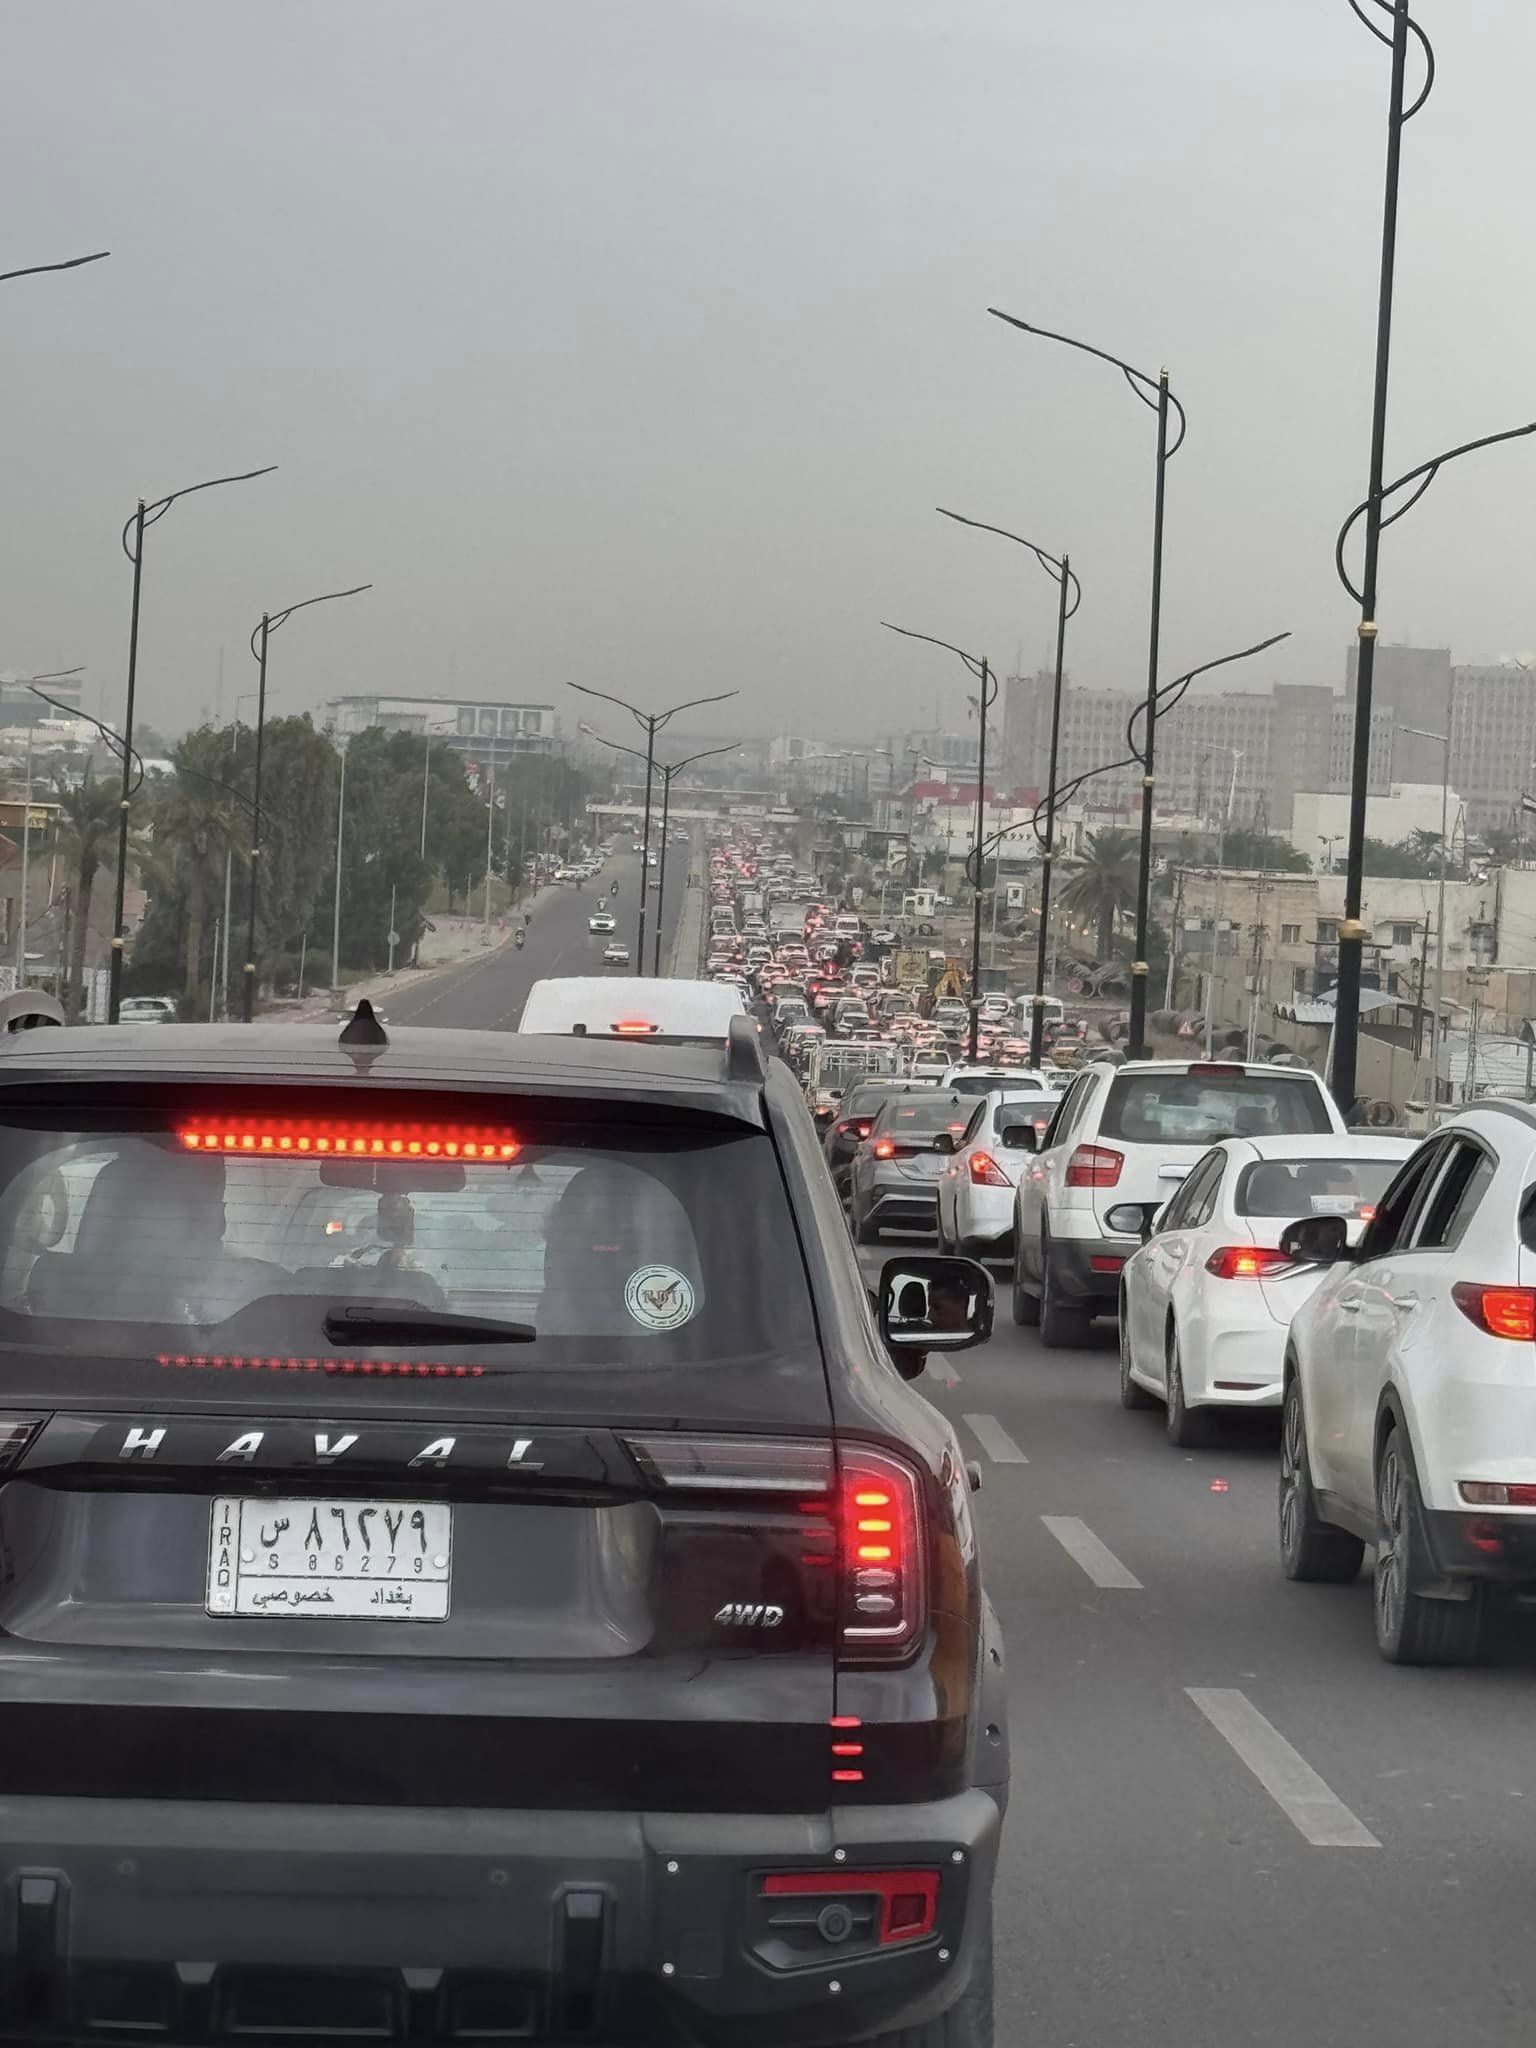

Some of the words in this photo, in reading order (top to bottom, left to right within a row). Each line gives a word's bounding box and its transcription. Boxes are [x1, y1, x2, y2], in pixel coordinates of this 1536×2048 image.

[118, 1427, 546, 1471] HAVAL
[304, 1506, 428, 1553] ٨٦٢٧٩
[252, 1586, 335, 1609] خصوصي
[370, 1585, 413, 1611] بغداد
[714, 1603, 784, 1627] 4WD
